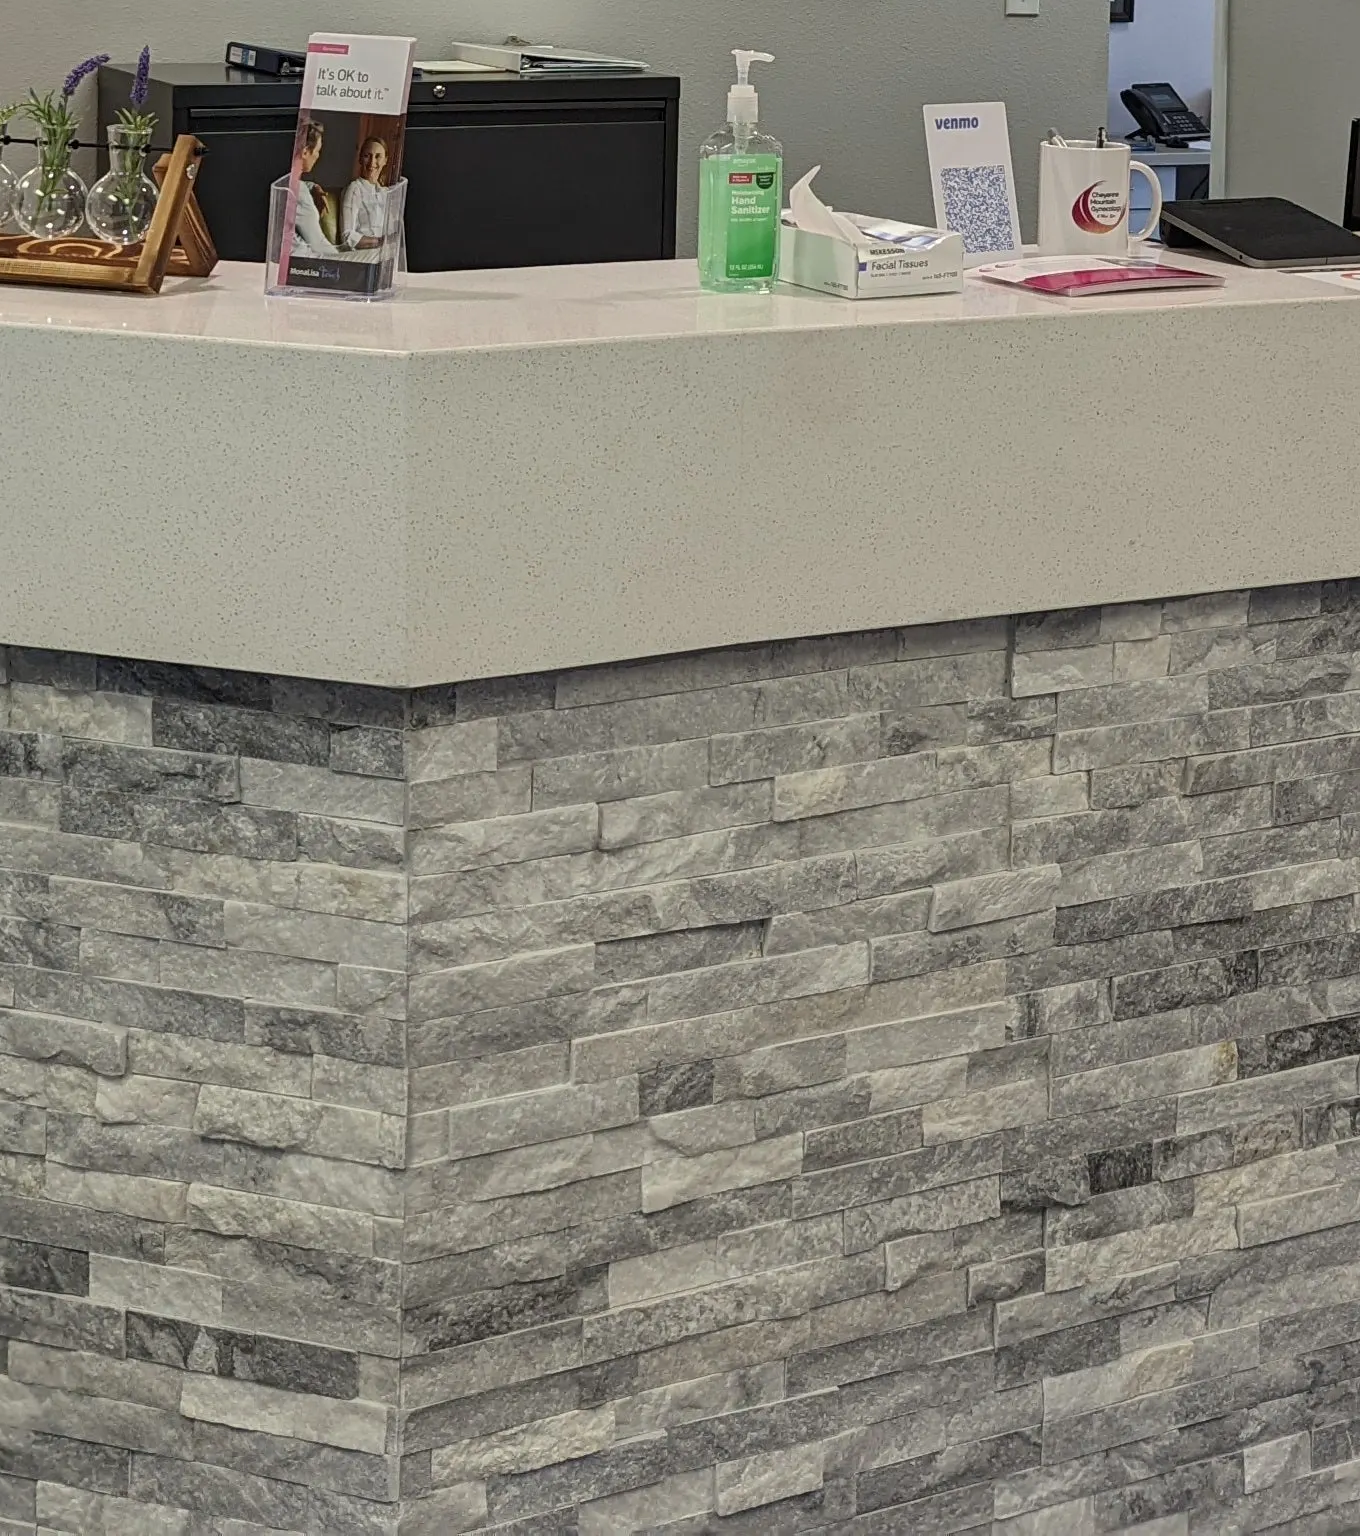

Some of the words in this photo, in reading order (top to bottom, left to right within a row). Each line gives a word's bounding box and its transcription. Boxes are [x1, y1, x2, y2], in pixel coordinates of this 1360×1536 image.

[317, 68, 335, 80] It's
[337, 69, 355, 82] OK
[357, 71, 369, 83] to
[316, 85, 337, 97] talk
[339, 86, 372, 100] about
[935, 117, 979, 130] venmo
[731, 196, 757, 205] Hand
[730, 205, 771, 215] Sanitizer
[871, 261, 897, 271] Facial
[898, 259, 929, 269] Tissues
[290, 267, 320, 277] MonaLisa
